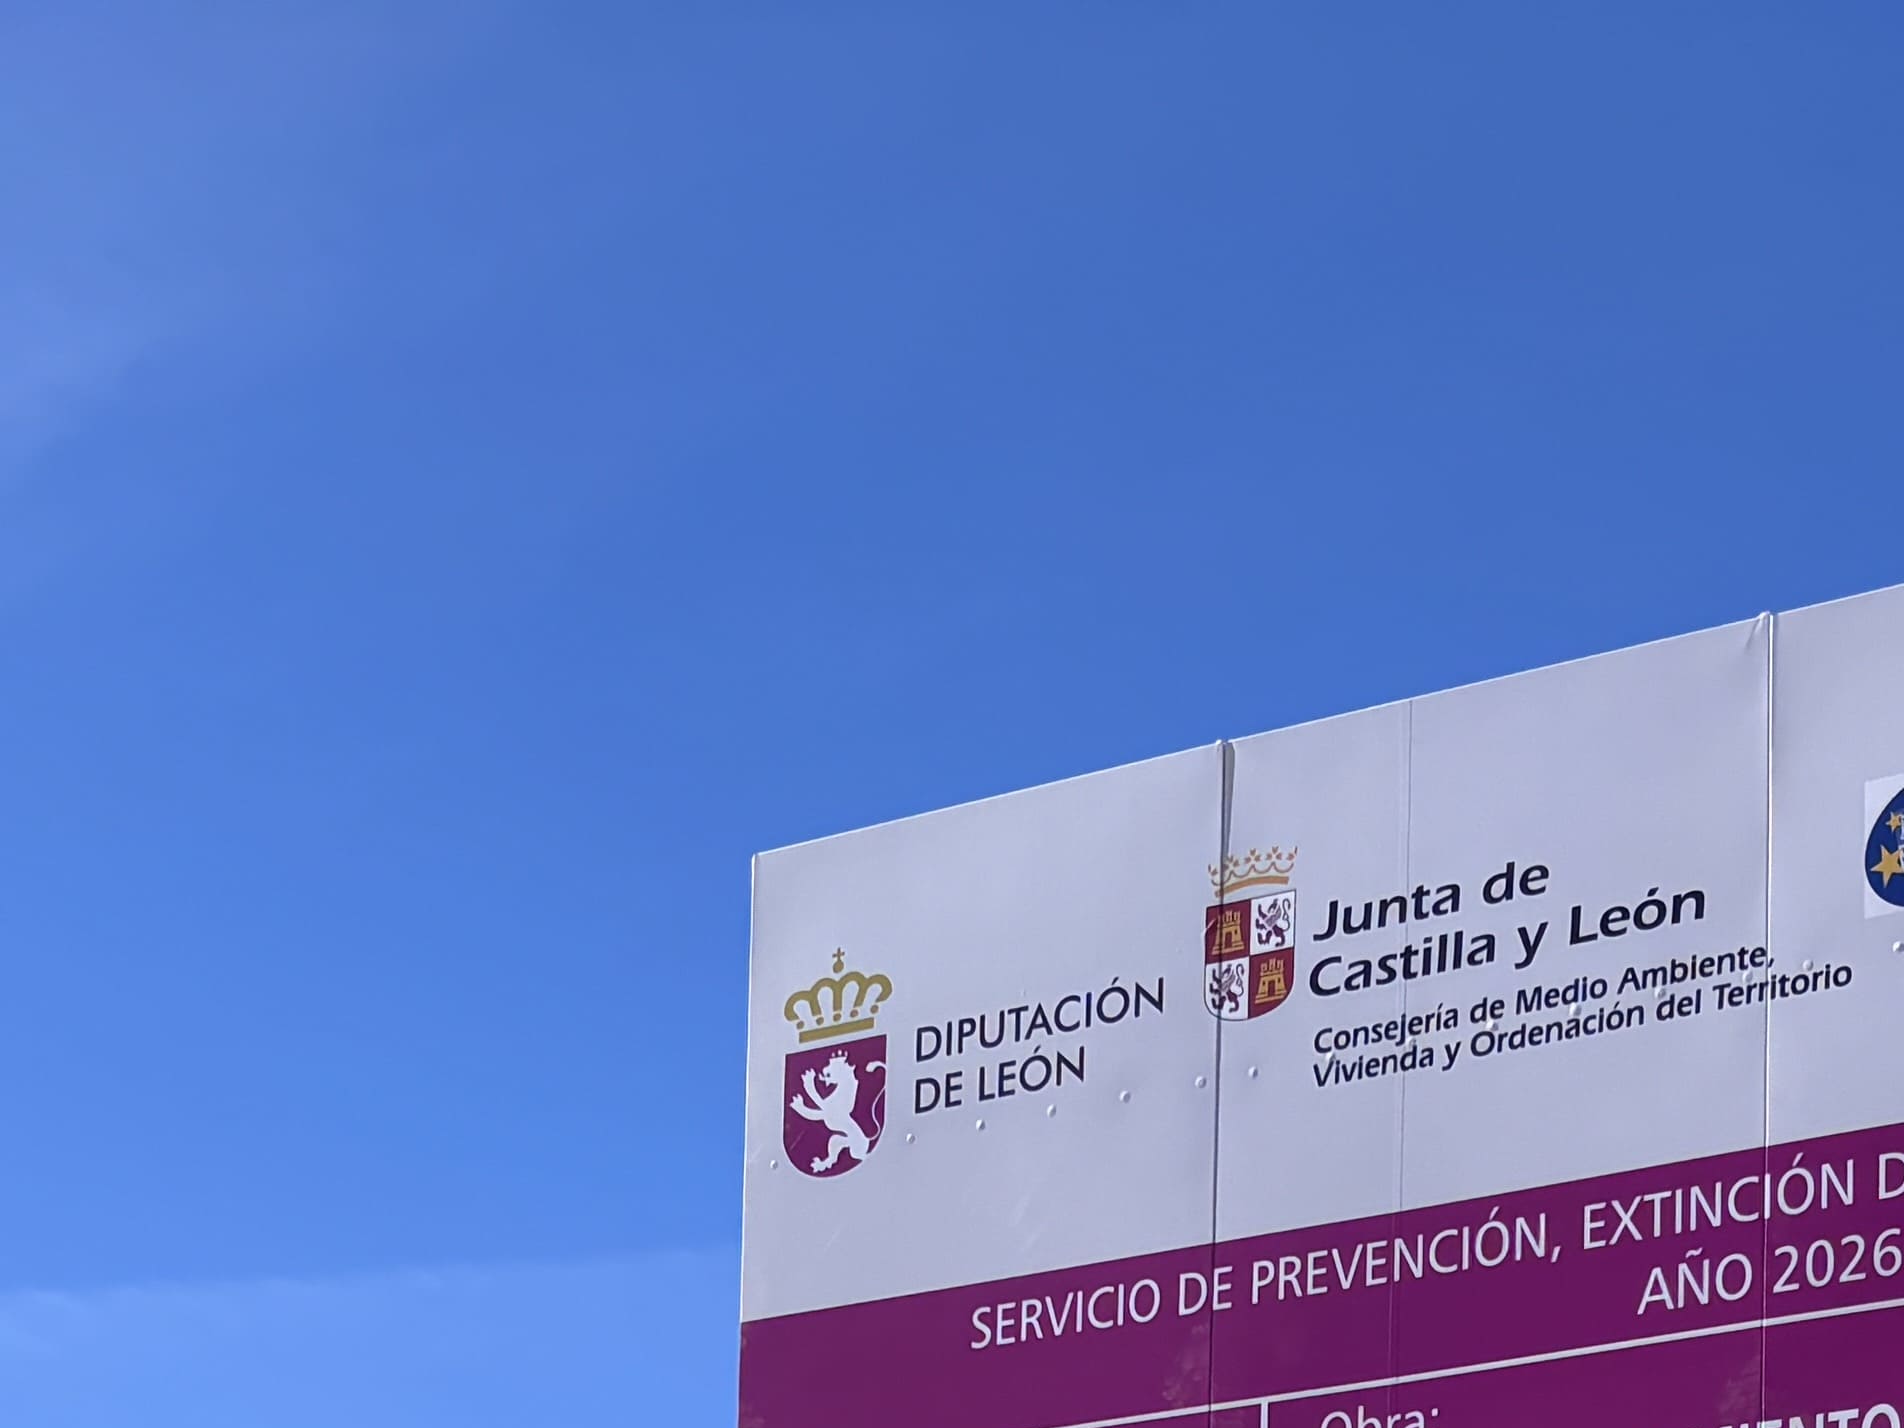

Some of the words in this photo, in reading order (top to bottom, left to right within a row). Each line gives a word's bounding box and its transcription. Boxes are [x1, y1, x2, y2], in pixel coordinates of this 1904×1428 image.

[1308, 929, 1496, 997] Castilla
[1513, 920, 1549, 969] y
[1568, 886, 1705, 946] León
[1312, 882, 1460, 942] Junta
[1481, 860, 1549, 905] de
[914, 975, 1164, 1063] DIPUTACIÓN
[1312, 1041, 1435, 1088] Vivienda
[1440, 1040, 1463, 1072] y
[1470, 1004, 1645, 1057] Ordenación
[1654, 985, 1704, 1023] del
[1714, 961, 1854, 1011] Territorio
[1313, 1005, 1460, 1055] Consejería
[1468, 995, 1505, 1027] de
[1514, 975, 1608, 1016] Medio
[1615, 941, 1775, 995] Ambiente,
[913, 1069, 963, 1114] DE
[977, 1044, 1085, 1102] LEÓN
[970, 1277, 1161, 1349] SERVICIO
[1177, 1265, 1233, 1316] DE
[1250, 1205, 1561, 1305] PREVENCIÓN,
[1582, 1151, 1854, 1253] EXTINCIÓN
[1636, 1246, 1752, 1315] AÑO
[1770, 1226, 1904, 1297] 2026
